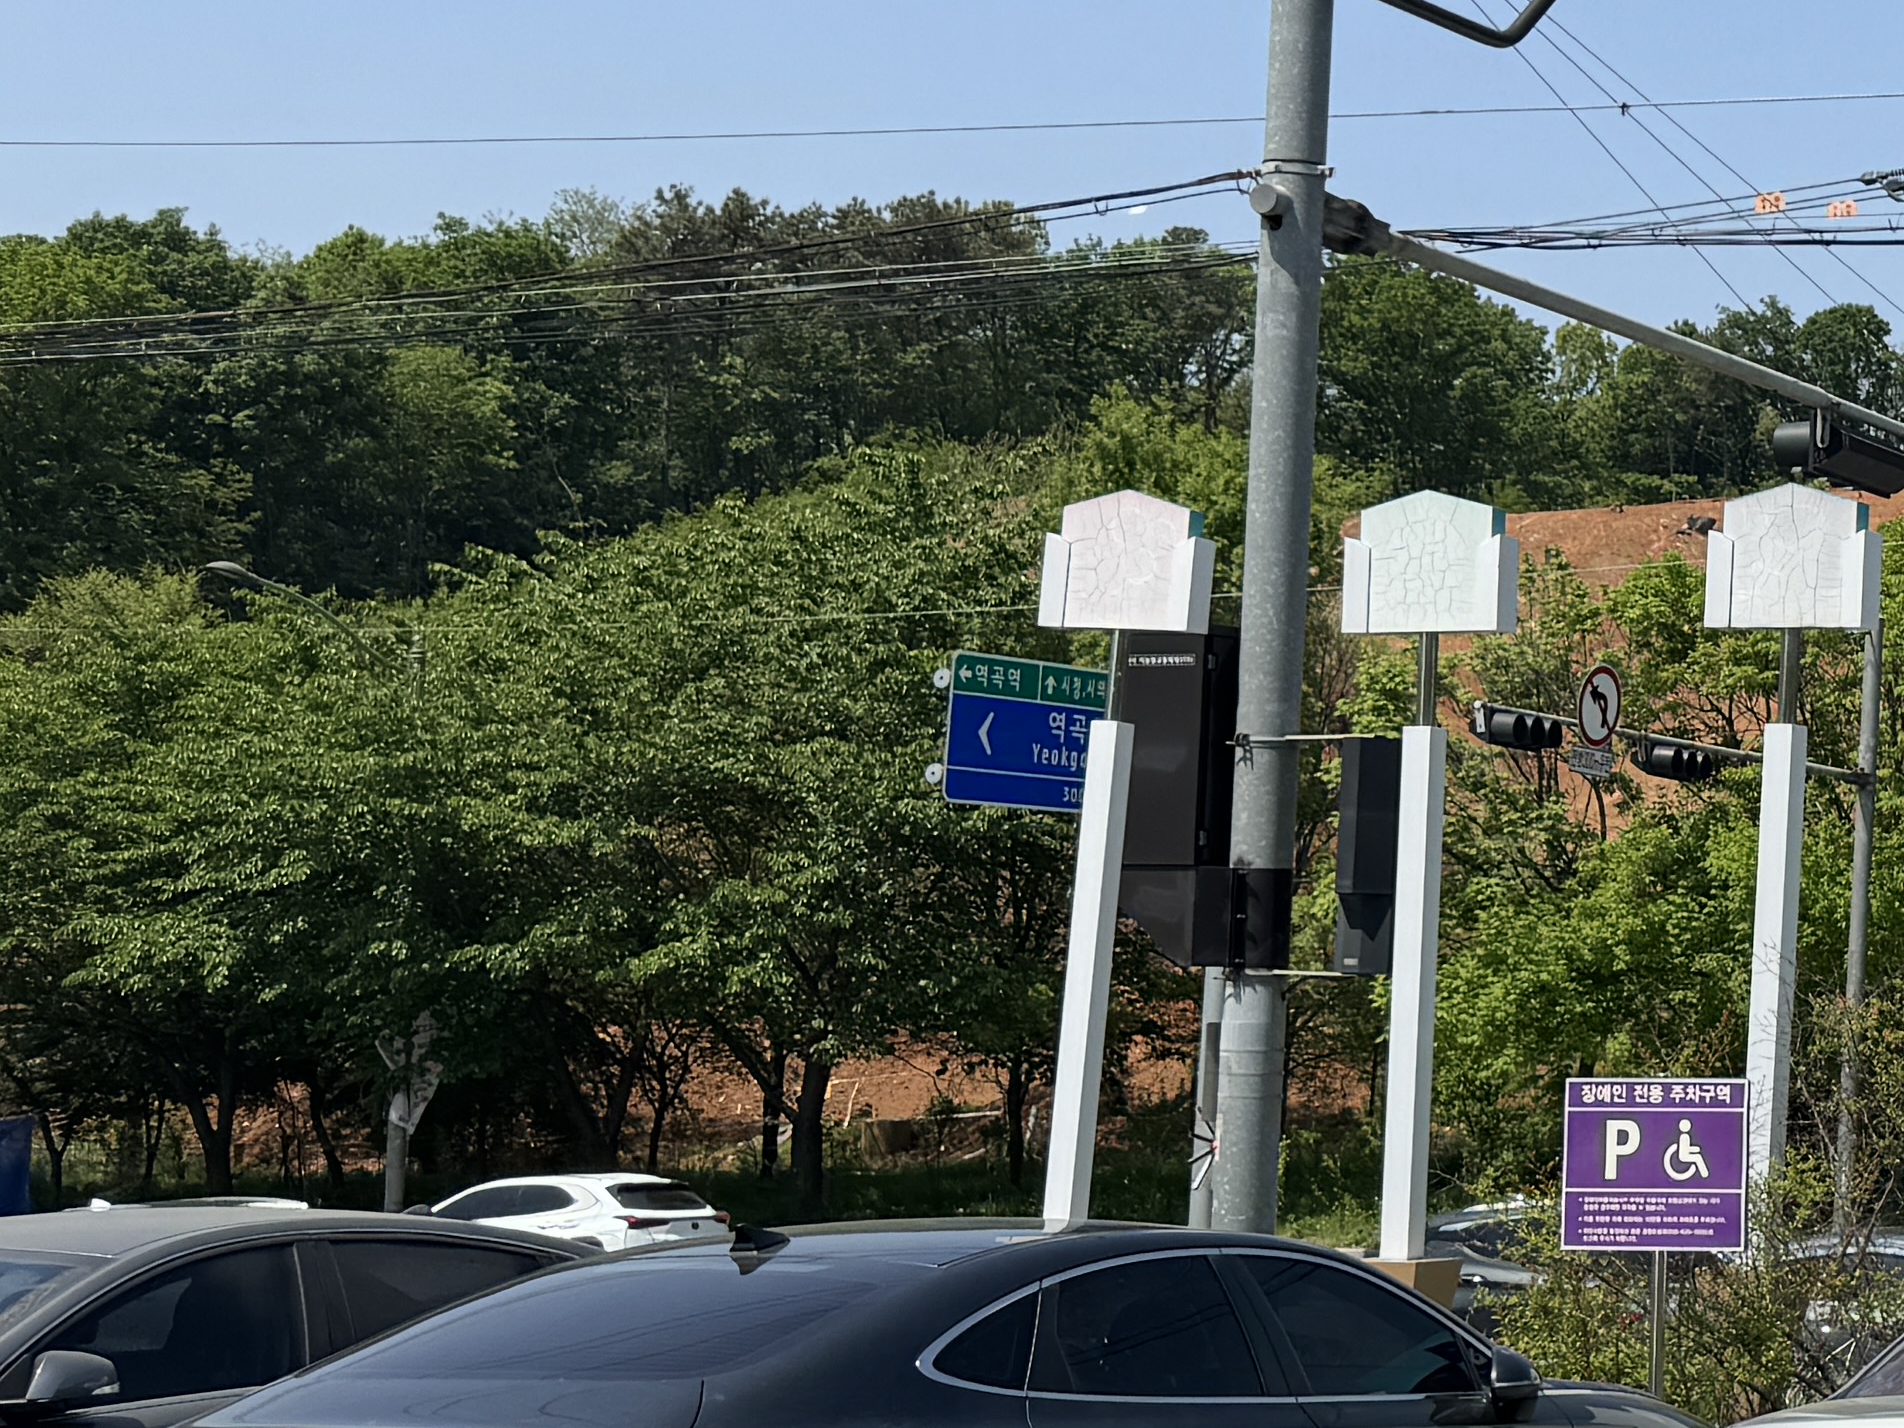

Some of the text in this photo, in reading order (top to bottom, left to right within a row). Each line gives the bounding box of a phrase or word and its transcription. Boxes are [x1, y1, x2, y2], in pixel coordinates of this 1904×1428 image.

[975, 664, 1021, 692] 역곡역
[1049, 712, 1088, 745] 역곡
[1581, 1084, 1731, 1104] 장애인 전용 주차구역
[1604, 1119, 1641, 1180] P
